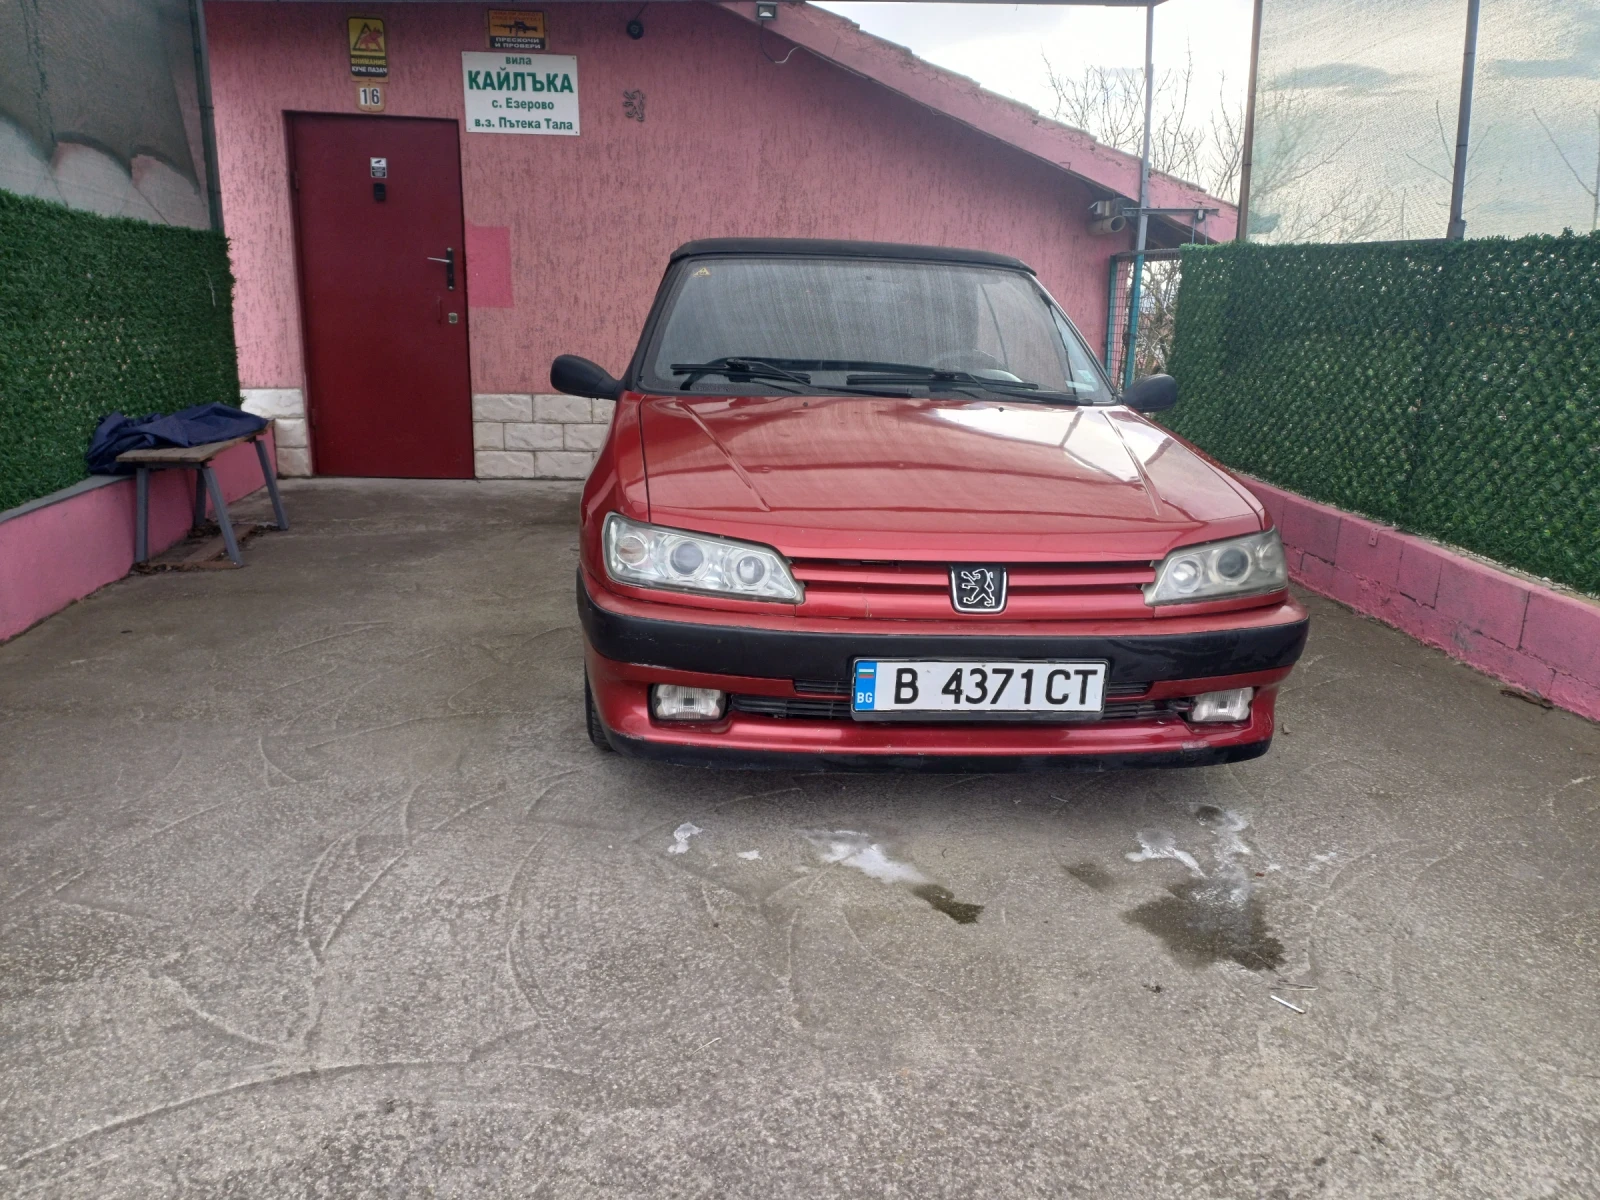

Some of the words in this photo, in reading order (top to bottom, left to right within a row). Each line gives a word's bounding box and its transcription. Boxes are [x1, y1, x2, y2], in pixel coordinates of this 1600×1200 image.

[351, 58, 387, 66] ВНИМАНИЕ
[505, 56, 532, 65] вила
[467, 66, 574, 93] КАЙЛЪКА
[361, 88, 380, 105] 16
[491, 99, 502, 109] с.
[505, 97, 555, 112] Езерово
[474, 118, 495, 128] в.з.
[498, 116, 541, 129] Пътека
[544, 118, 573, 130] Тала
[894, 668, 919, 705] B
[857, 692, 873, 704] BG
